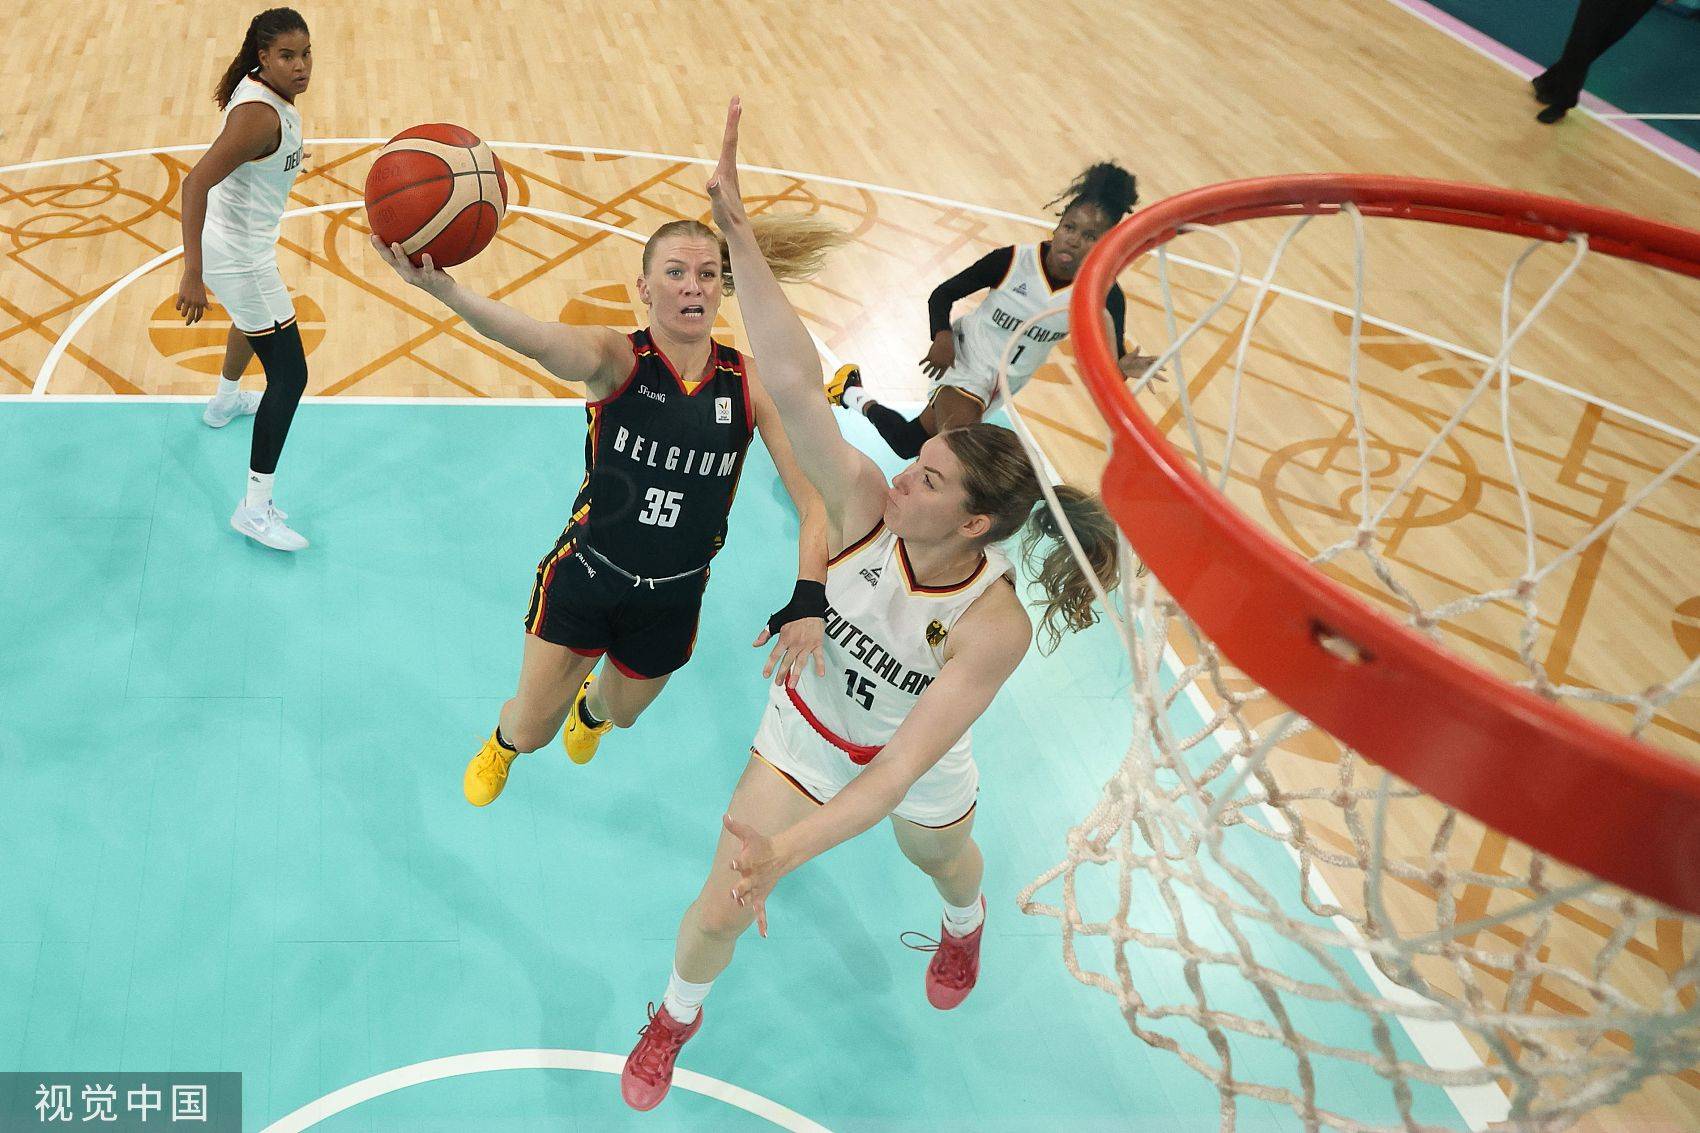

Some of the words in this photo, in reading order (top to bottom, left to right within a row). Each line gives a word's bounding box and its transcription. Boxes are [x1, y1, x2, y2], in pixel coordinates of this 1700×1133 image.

[1010, 344, 1027, 365] 1
[613, 425, 738, 477] BELGIUM
[638, 487, 685, 528] 35
[823, 606, 936, 695] EUTSCHLAN
[844, 668, 877, 712] 15
